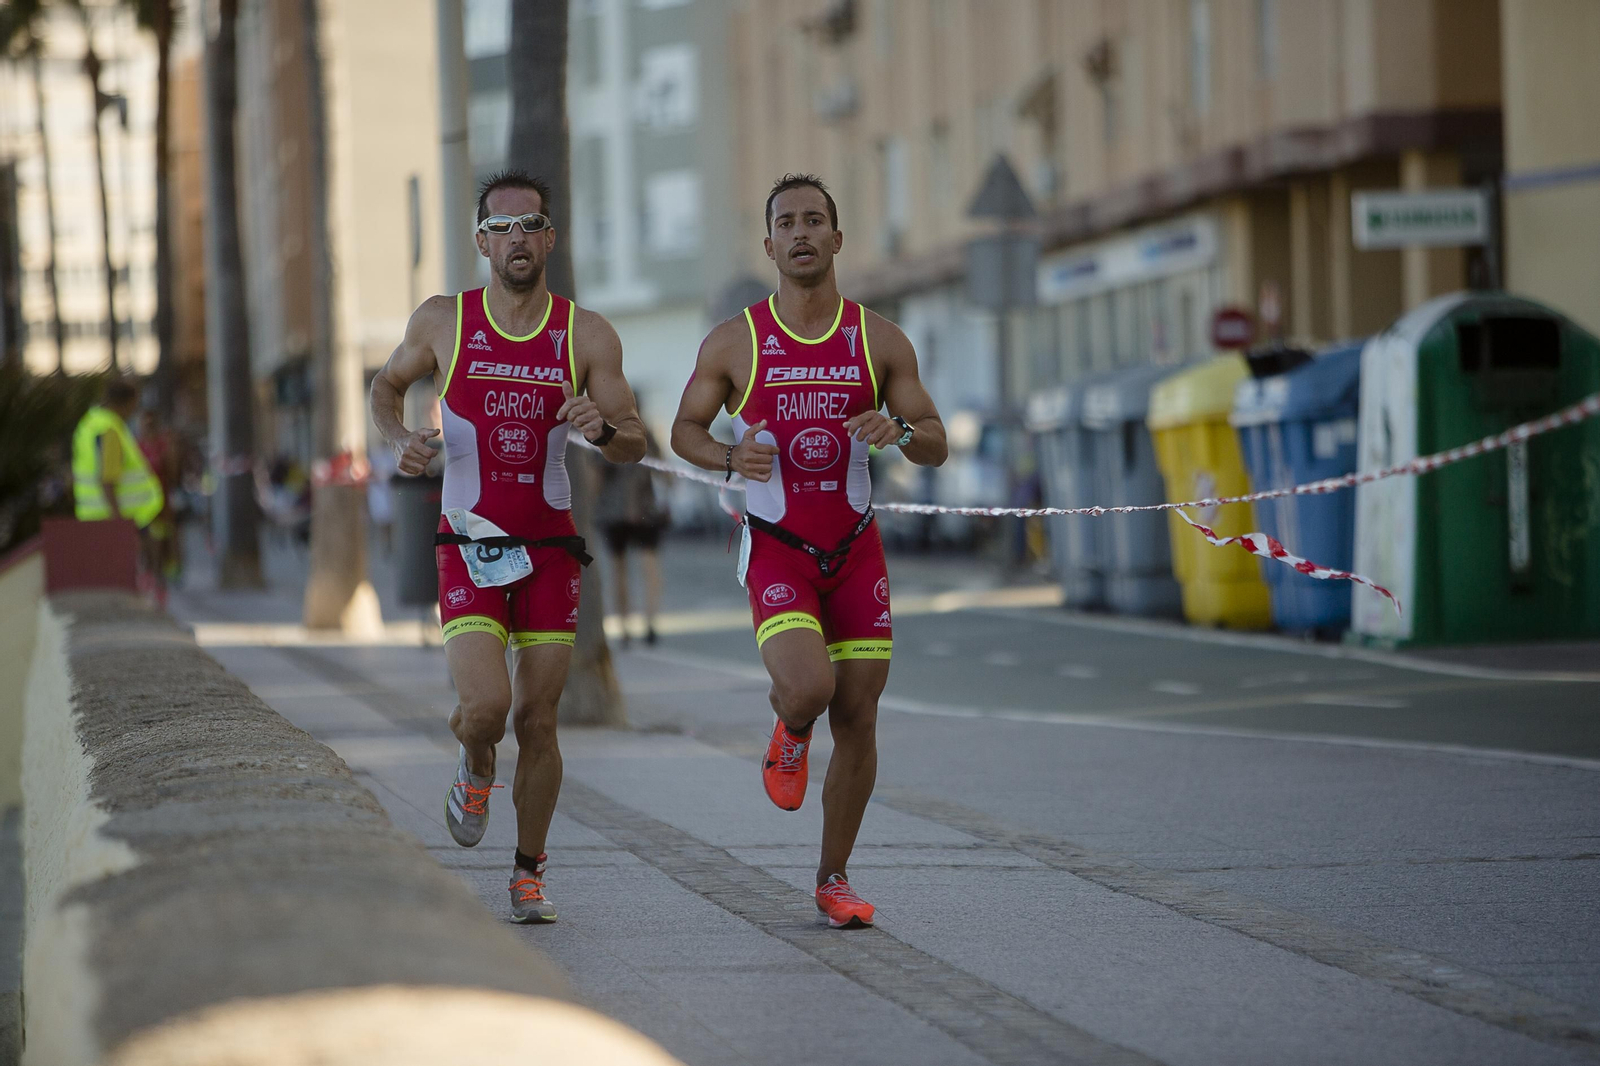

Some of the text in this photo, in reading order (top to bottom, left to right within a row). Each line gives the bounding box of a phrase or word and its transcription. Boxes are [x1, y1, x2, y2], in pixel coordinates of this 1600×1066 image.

[467, 360, 564, 382] ISBILYA
[765, 365, 860, 381] ISBILYA
[484, 388, 544, 420] GARCÍA
[776, 391, 850, 421] RAMIREZ
